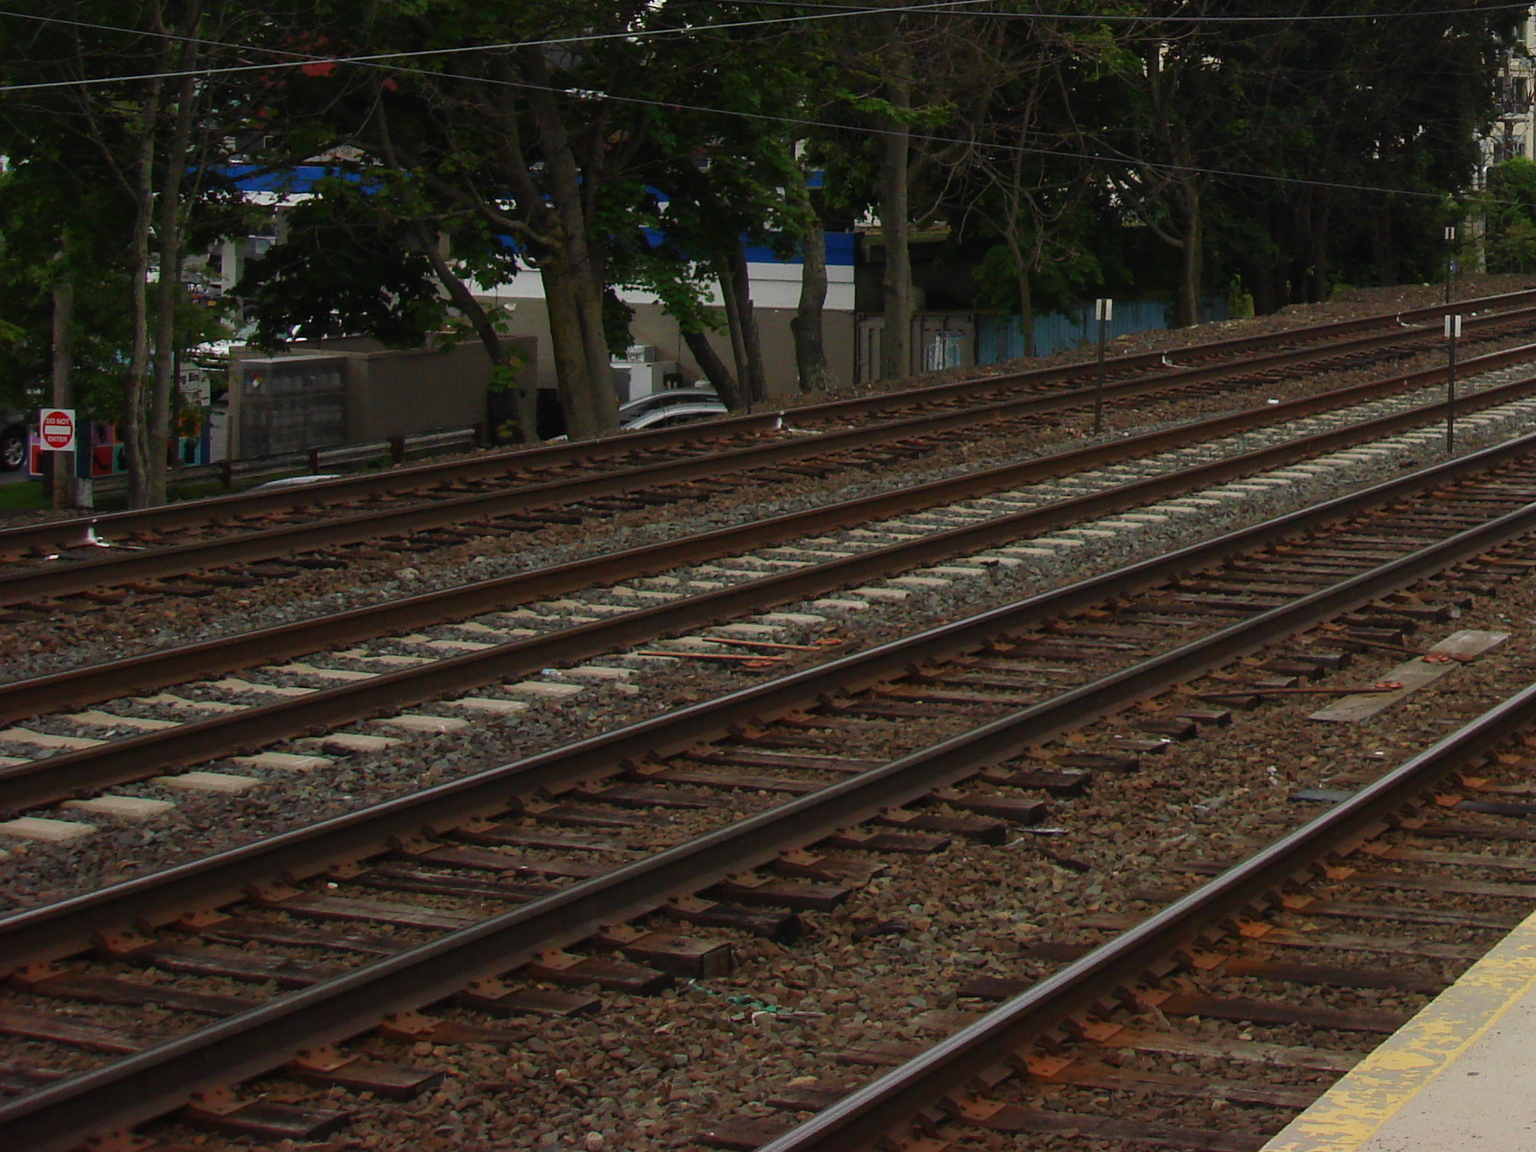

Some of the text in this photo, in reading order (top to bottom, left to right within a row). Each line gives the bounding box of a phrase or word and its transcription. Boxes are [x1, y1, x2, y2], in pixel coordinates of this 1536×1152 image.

[46, 417, 70, 425] DO NOT
[47, 435, 68, 443] ENTER
